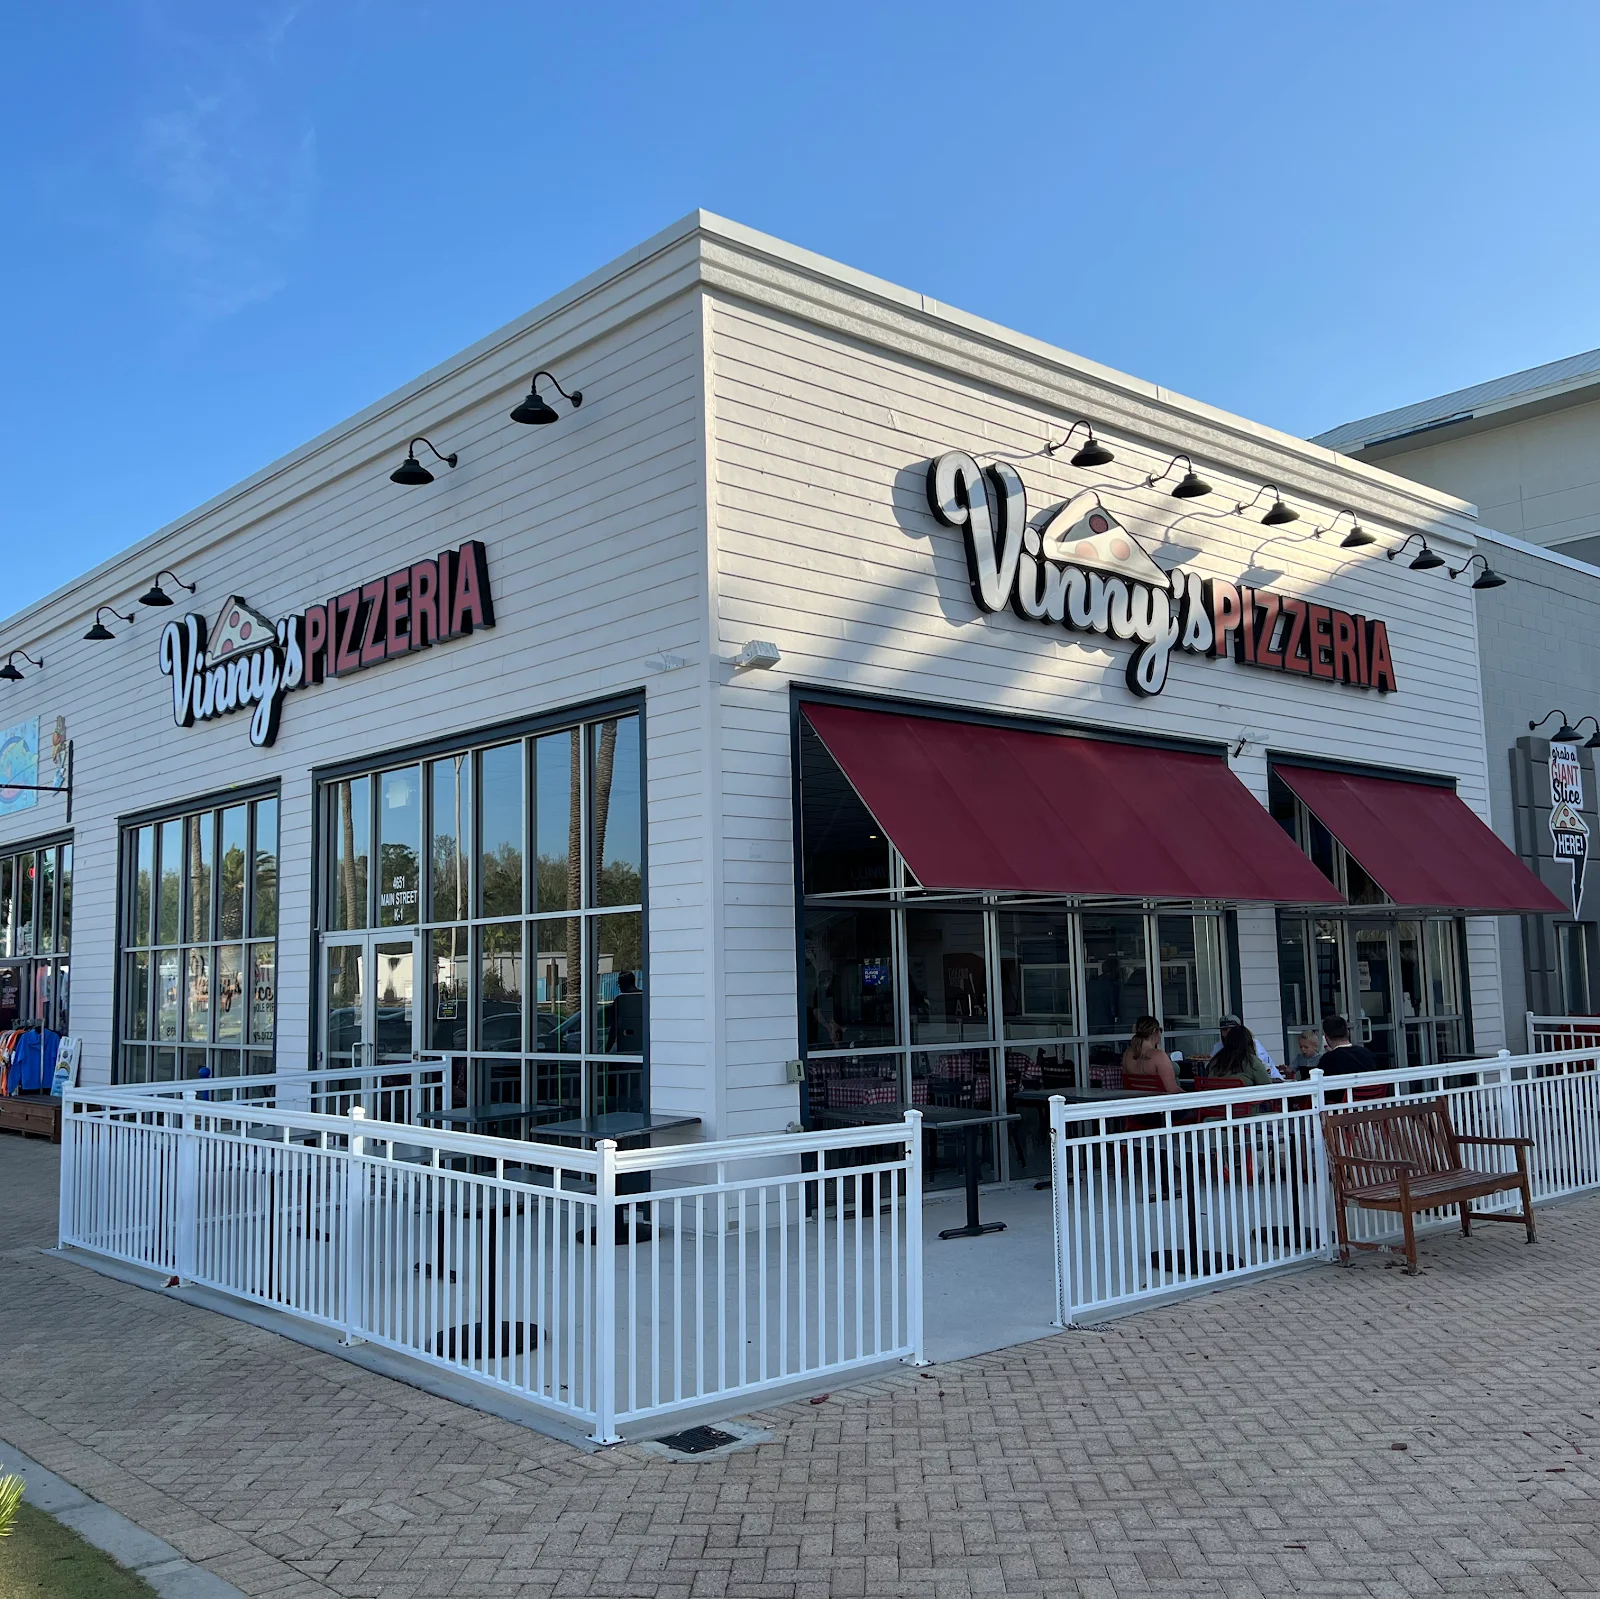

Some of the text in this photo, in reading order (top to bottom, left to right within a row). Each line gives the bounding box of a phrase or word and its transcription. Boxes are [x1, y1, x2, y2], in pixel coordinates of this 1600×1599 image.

[926, 450, 1397, 698] Vinny's PIZZERIA
[159, 540, 495, 747] Vinny's PIZZERIA
[1551, 746, 1570, 762] grab
[1551, 762, 1579, 787] GIANT
[1552, 778, 1582, 804] Slice
[1557, 833, 1584, 856] HERE!
[392, 875, 405, 889] 4651
[381, 890, 418, 906] MAIN STREET
